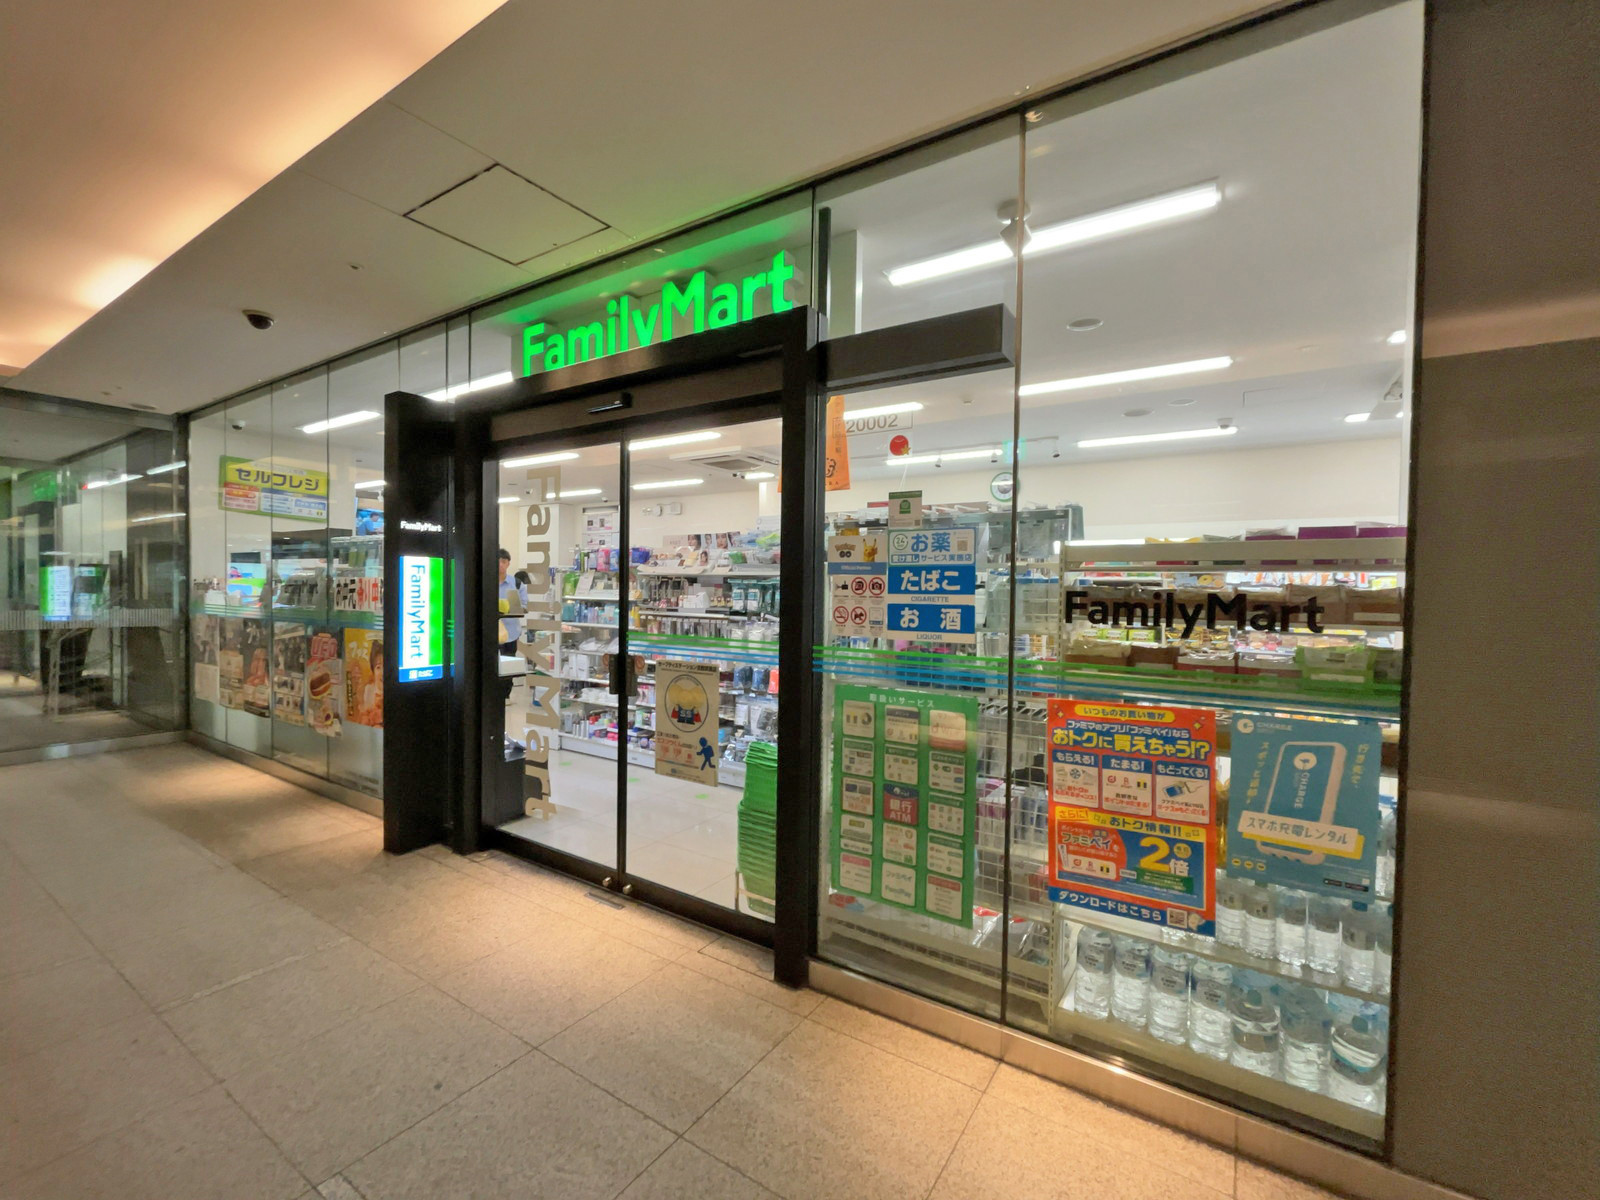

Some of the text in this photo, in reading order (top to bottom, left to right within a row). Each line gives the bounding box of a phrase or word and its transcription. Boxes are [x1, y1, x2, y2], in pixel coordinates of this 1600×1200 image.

[523, 249, 793, 377] FamilyMart
[846, 414, 898, 433] 20002
[236, 468, 319, 491] セルフレジ
[400, 520, 442, 532] FamilyMart
[911, 532, 951, 552] お薬
[900, 569, 961, 591] たばこ
[407, 564, 426, 659] FamilyMart
[1065, 590, 1324, 639] FamilyMart
[519, 465, 561, 821] FamilyMart
[1083, 707, 1166, 720] いつものお買い物が
[1067, 720, 1190, 738] ファミマのアプリ「ファミペイ」なら
[1056, 751, 1095, 766] もらえる!
[1111, 758, 1145, 771] たまる!
[1157, 764, 1208, 778] もどってくる!
[889, 798, 912, 813] 銀行
[889, 811, 911, 823] ATM
[1246, 816, 1348, 845] スマホ充電レンタル
[1058, 891, 1162, 922] ダウンロードはこちら
